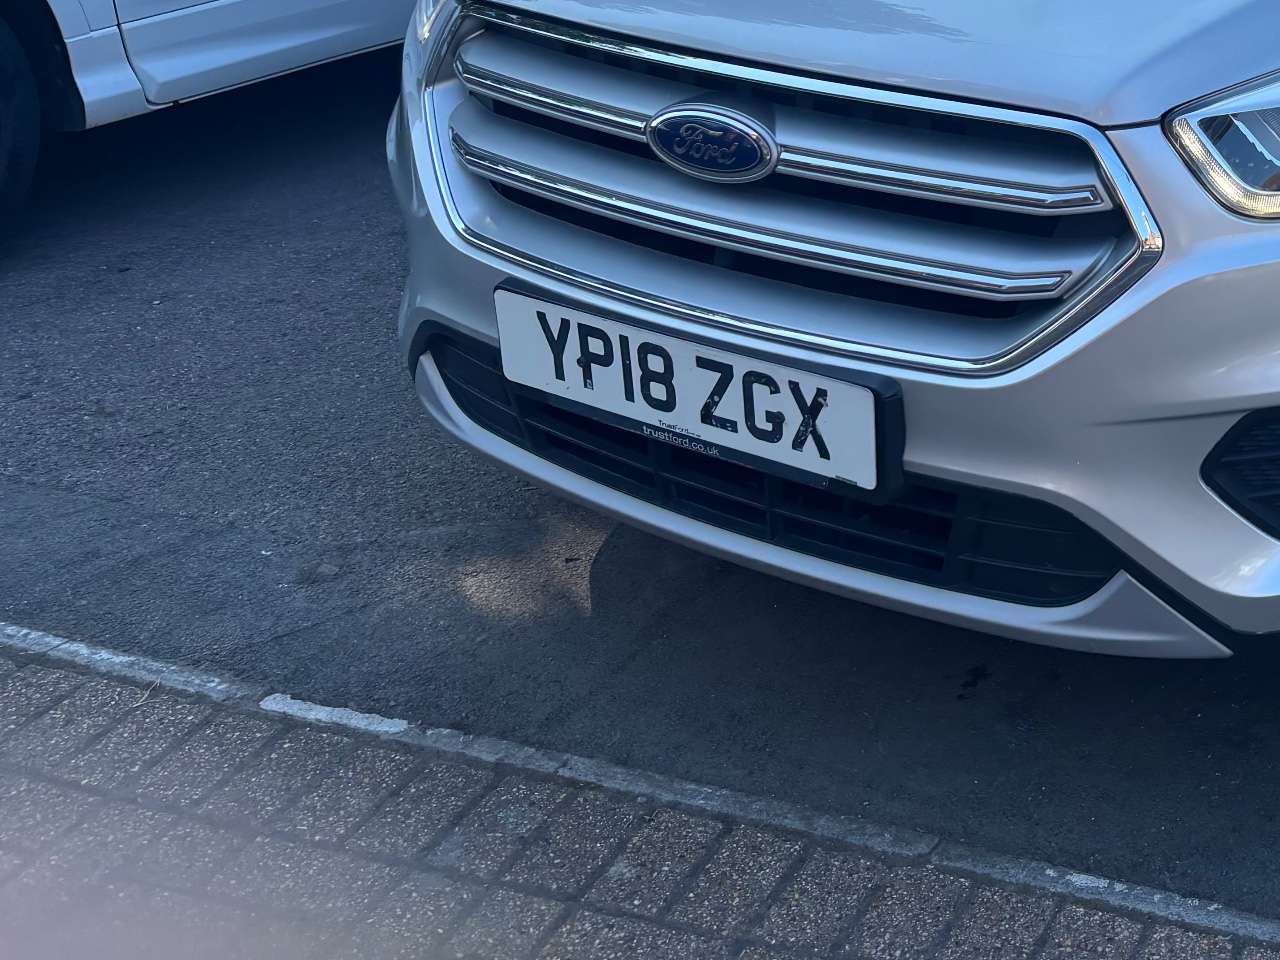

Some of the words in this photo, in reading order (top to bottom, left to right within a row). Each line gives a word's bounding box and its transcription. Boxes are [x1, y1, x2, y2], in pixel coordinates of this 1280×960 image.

[536, 310, 677, 414] YP18
[695, 354, 832, 461] ZGX
[643, 425, 720, 456] trustford.co.uk
